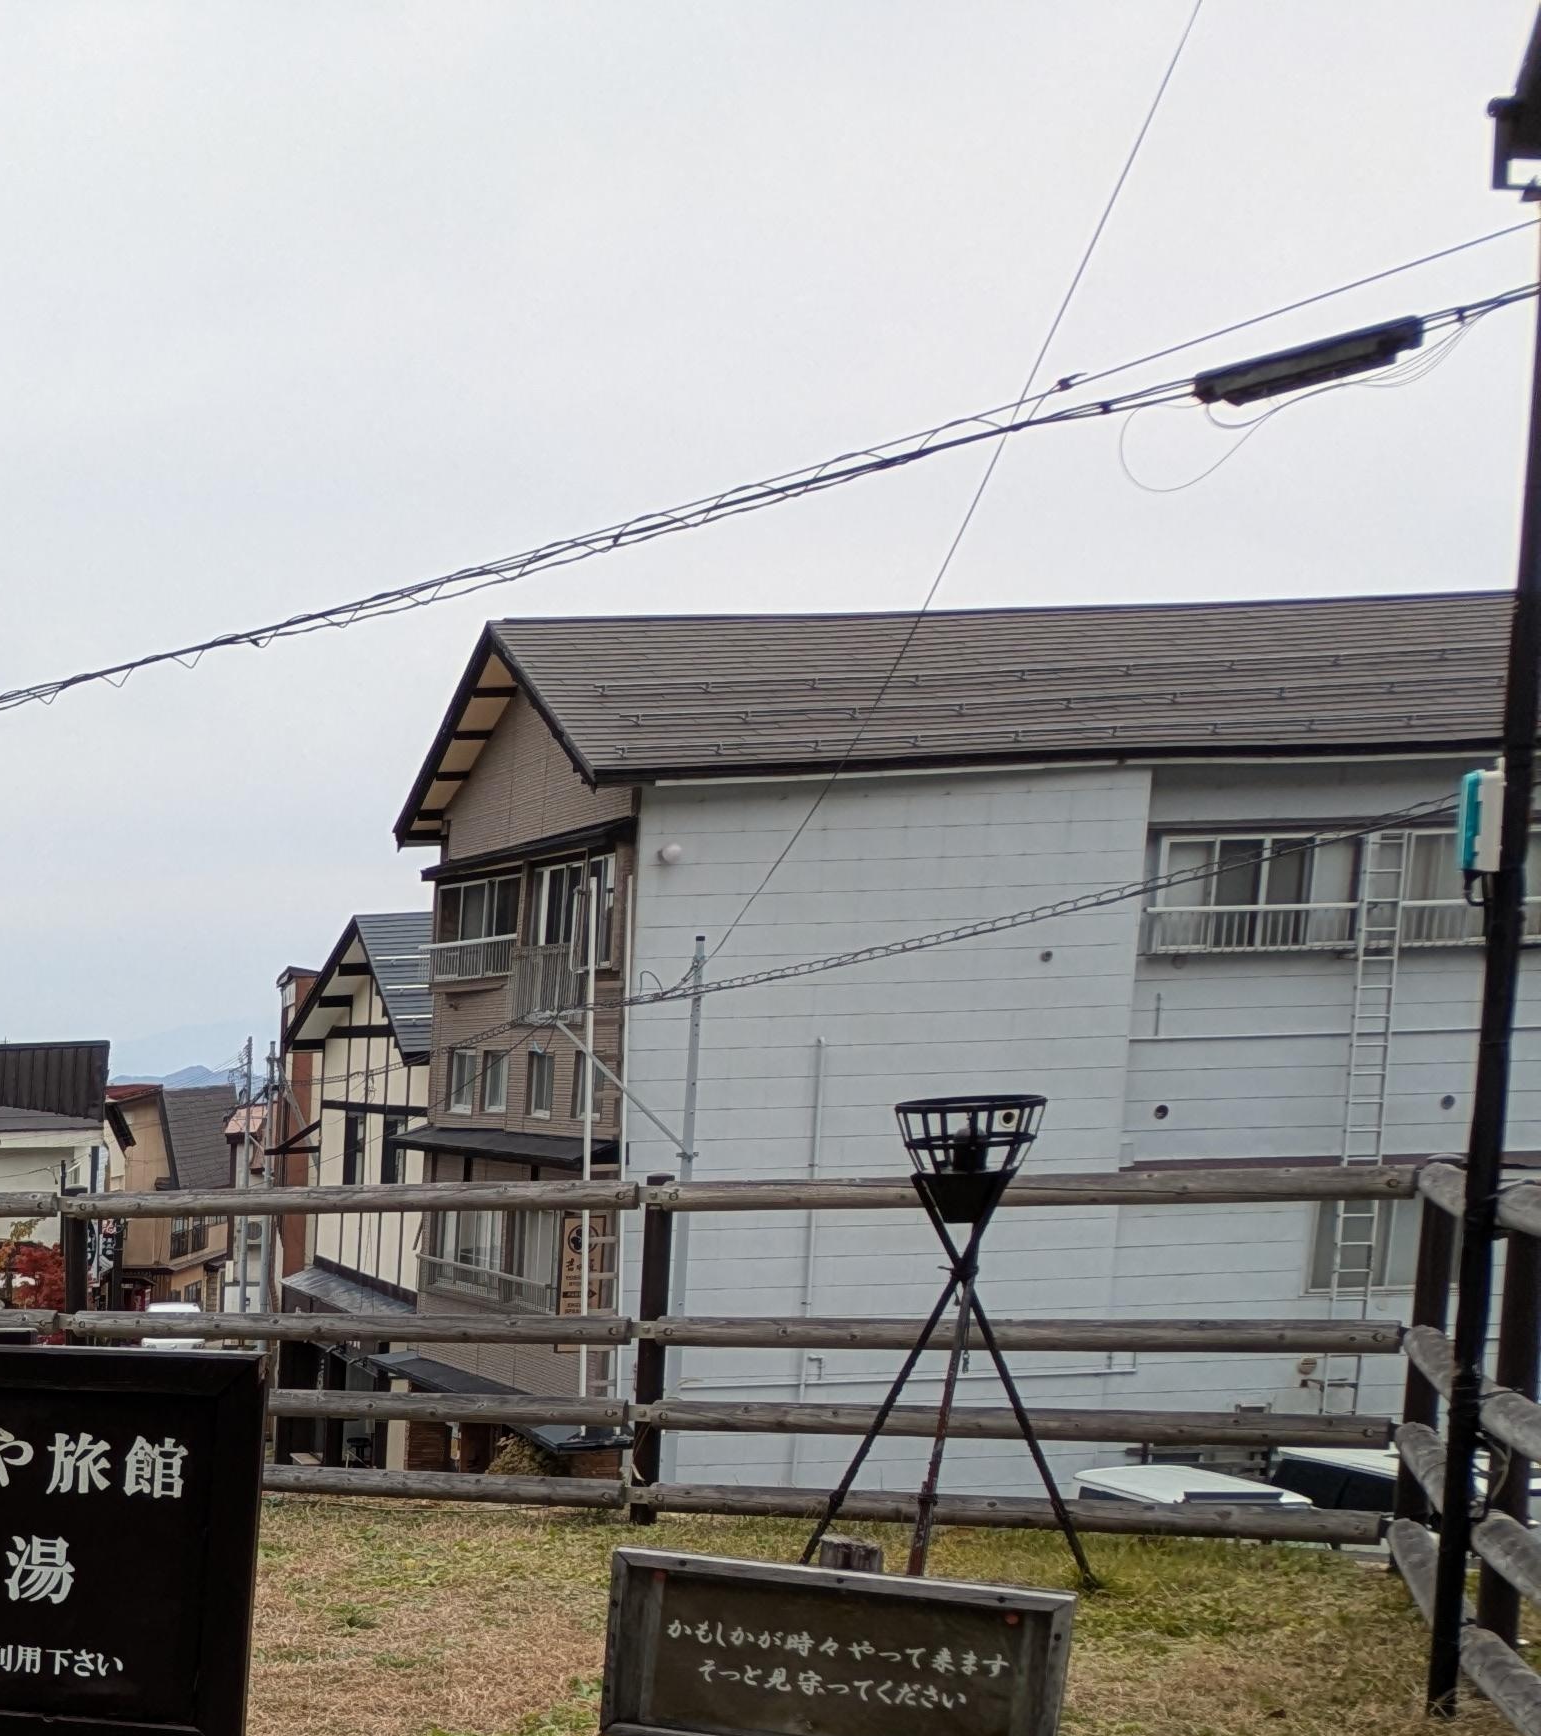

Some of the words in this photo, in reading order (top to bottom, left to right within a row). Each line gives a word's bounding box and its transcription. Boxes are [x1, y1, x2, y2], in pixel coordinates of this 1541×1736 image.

[666, 1618, 1010, 1678] かもしかが時々やって来ます
[698, 1659, 967, 1710] そっと見守ってください
